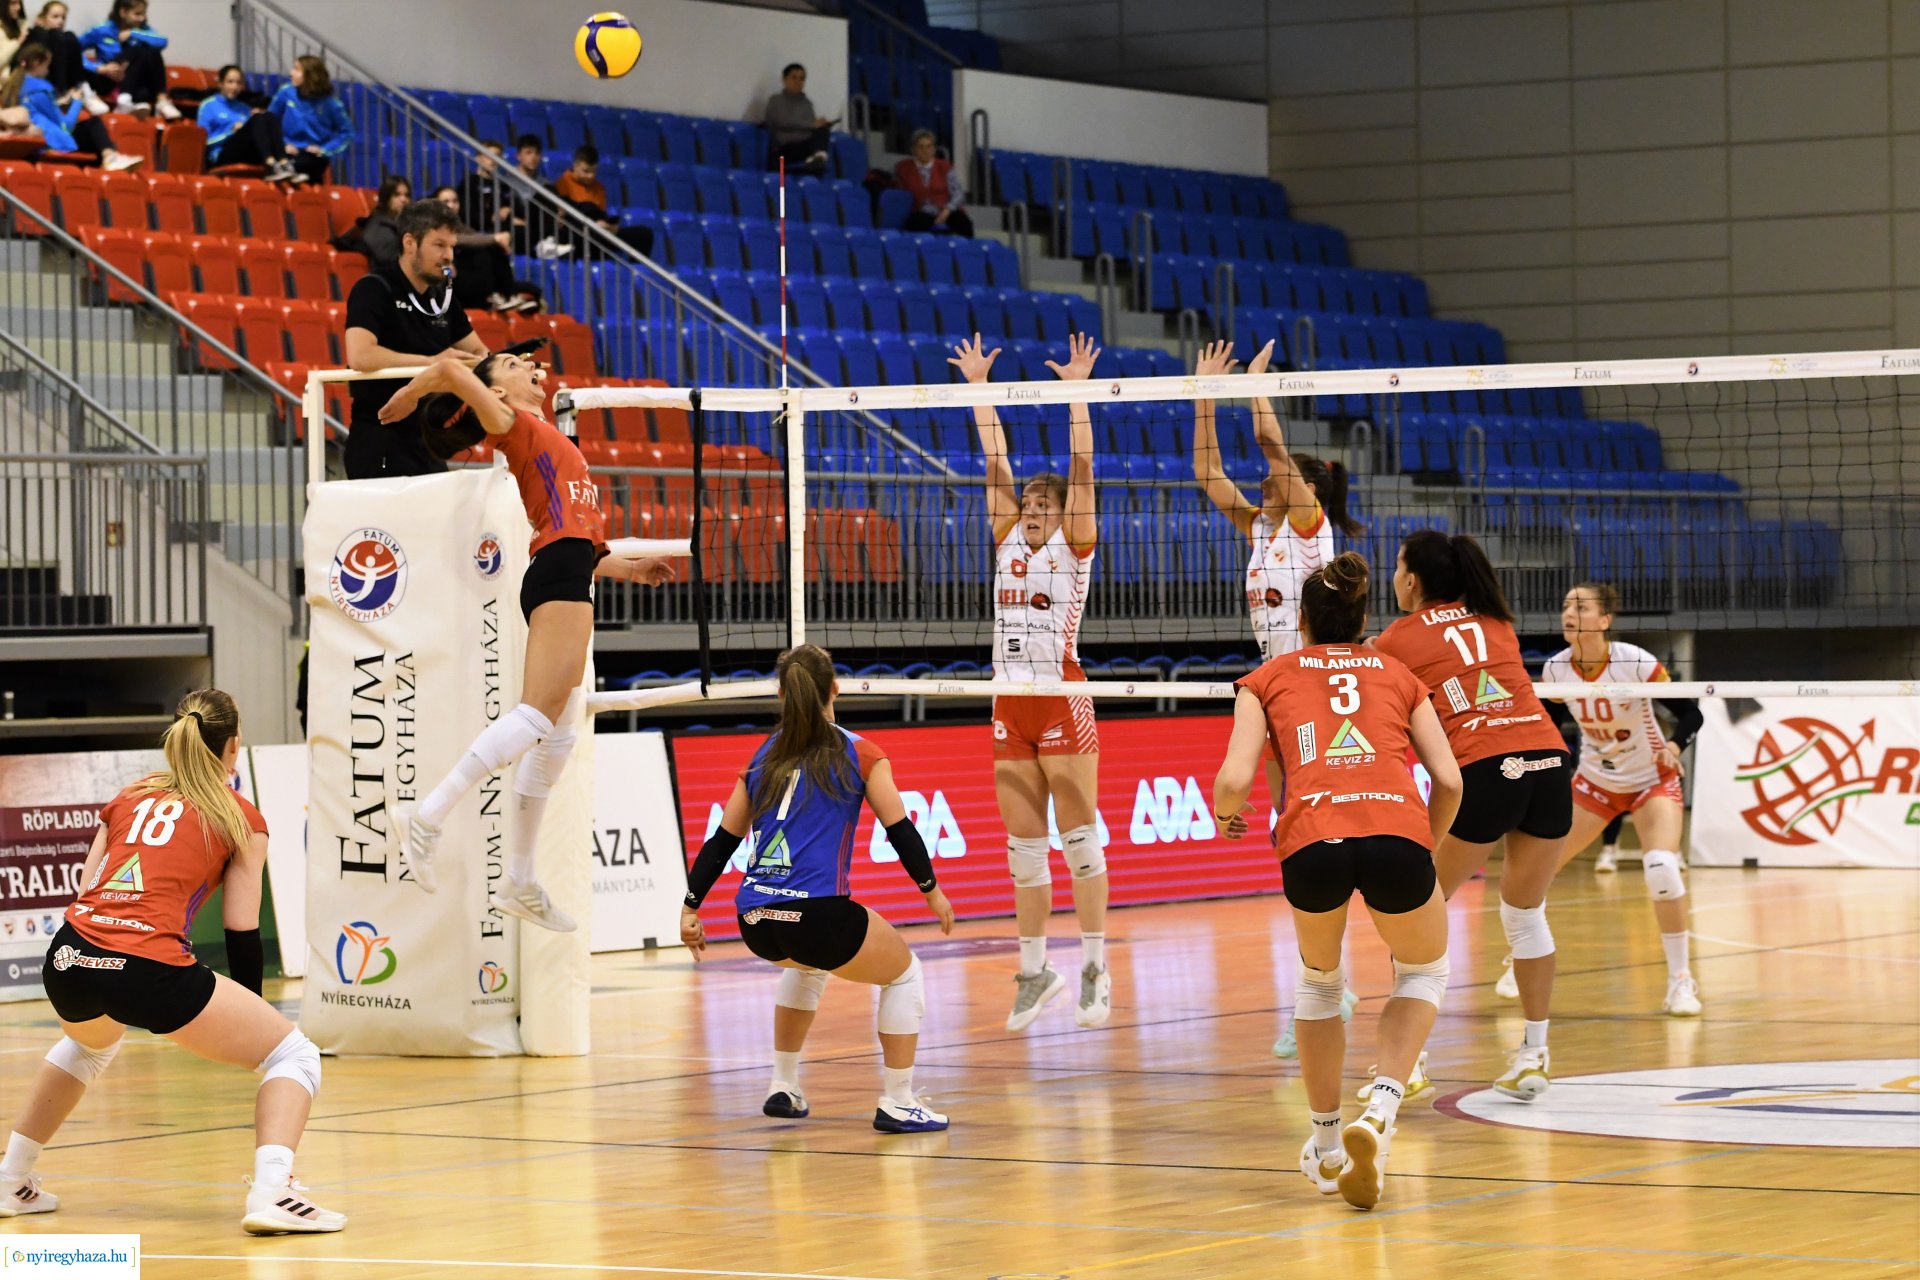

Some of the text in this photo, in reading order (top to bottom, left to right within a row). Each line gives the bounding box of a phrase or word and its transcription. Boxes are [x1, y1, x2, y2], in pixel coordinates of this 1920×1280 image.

[1007, 386, 1041, 400] FATUM
[1278, 377, 1315, 391] FATUM
[363, 530, 400, 555] FATUM
[1443, 622, 1488, 667] 17
[1299, 656, 1384, 669] MILANOVA
[1328, 673, 1361, 716] 3
[1487, 713, 1542, 727] BESTRONG
[1576, 698, 1614, 723] 10
[994, 720, 1007, 740] 6
[336, 650, 387, 883] FATUM
[392, 651, 416, 883] NEGYHÁZA
[480, 598, 503, 941] FATUM-NYGYHÁZA
[1326, 754, 1376, 766] KE-VIZ 21
[1870, 747, 1920, 794] R
[1331, 792, 1405, 804] BESTRONG
[22, 808, 101, 832] RÖPLABDA
[1130, 776, 1216, 845] ADA
[125, 797, 184, 846] 18
[100, 892, 129, 901] KE-VIZ
[754, 885, 808, 898] BESTRONG
[91, 914, 156, 933] BESTRONG
[763, 909, 801, 921] REVESZ
[76, 957, 126, 970] REVESZ
[321, 991, 412, 1010] NYÍREGYHÁZA
